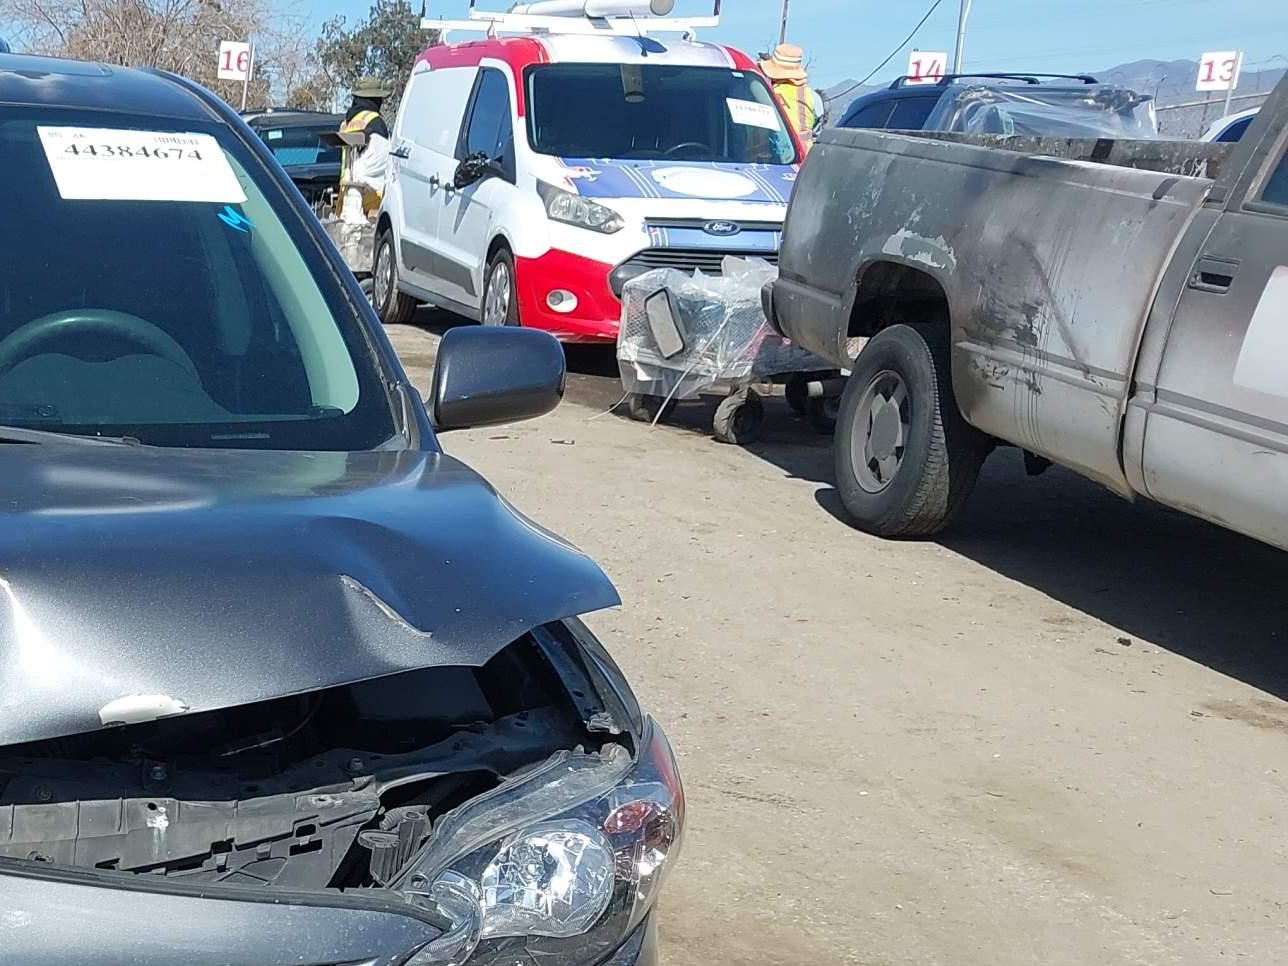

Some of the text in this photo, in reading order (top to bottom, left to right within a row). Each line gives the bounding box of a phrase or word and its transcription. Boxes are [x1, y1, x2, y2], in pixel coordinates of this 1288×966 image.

[220, 50, 249, 72] 16
[910, 59, 941, 82] 14
[1200, 60, 1235, 82] 13
[64, 143, 203, 161] 44384674
